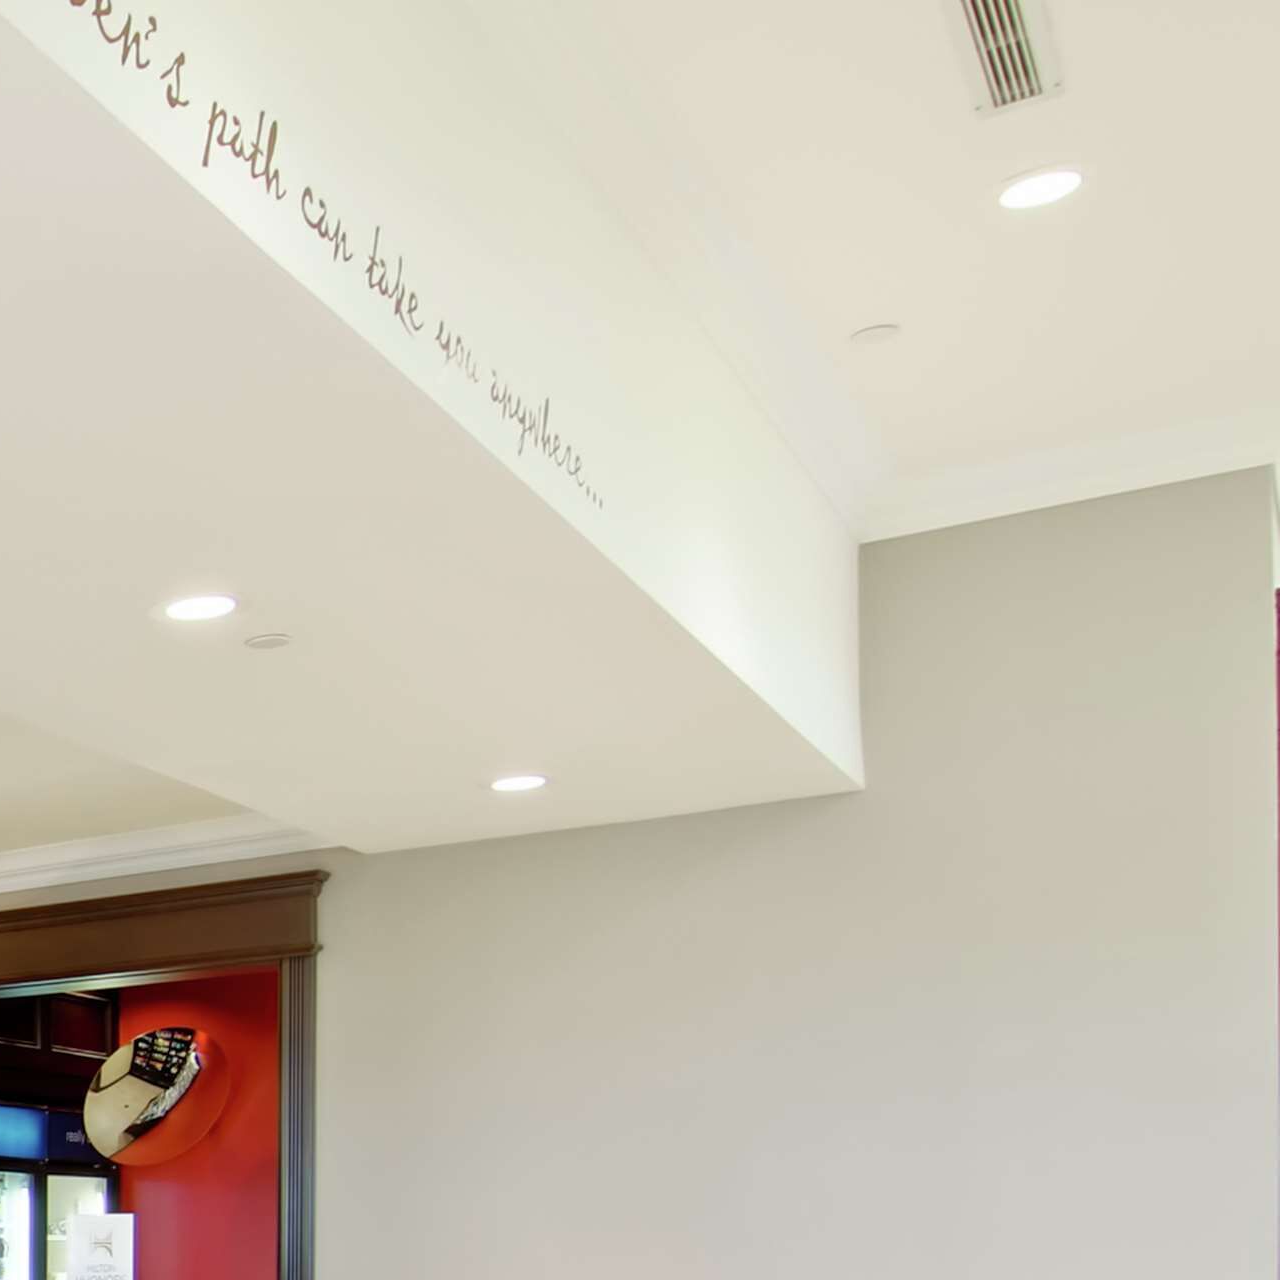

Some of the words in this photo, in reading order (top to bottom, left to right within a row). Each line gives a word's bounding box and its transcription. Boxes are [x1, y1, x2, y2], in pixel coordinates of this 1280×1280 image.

[69, 0, 189, 108] en's
[202, 101, 286, 200] path
[302, 186, 353, 262] can
[365, 226, 424, 337] take
[435, 320, 478, 384] you
